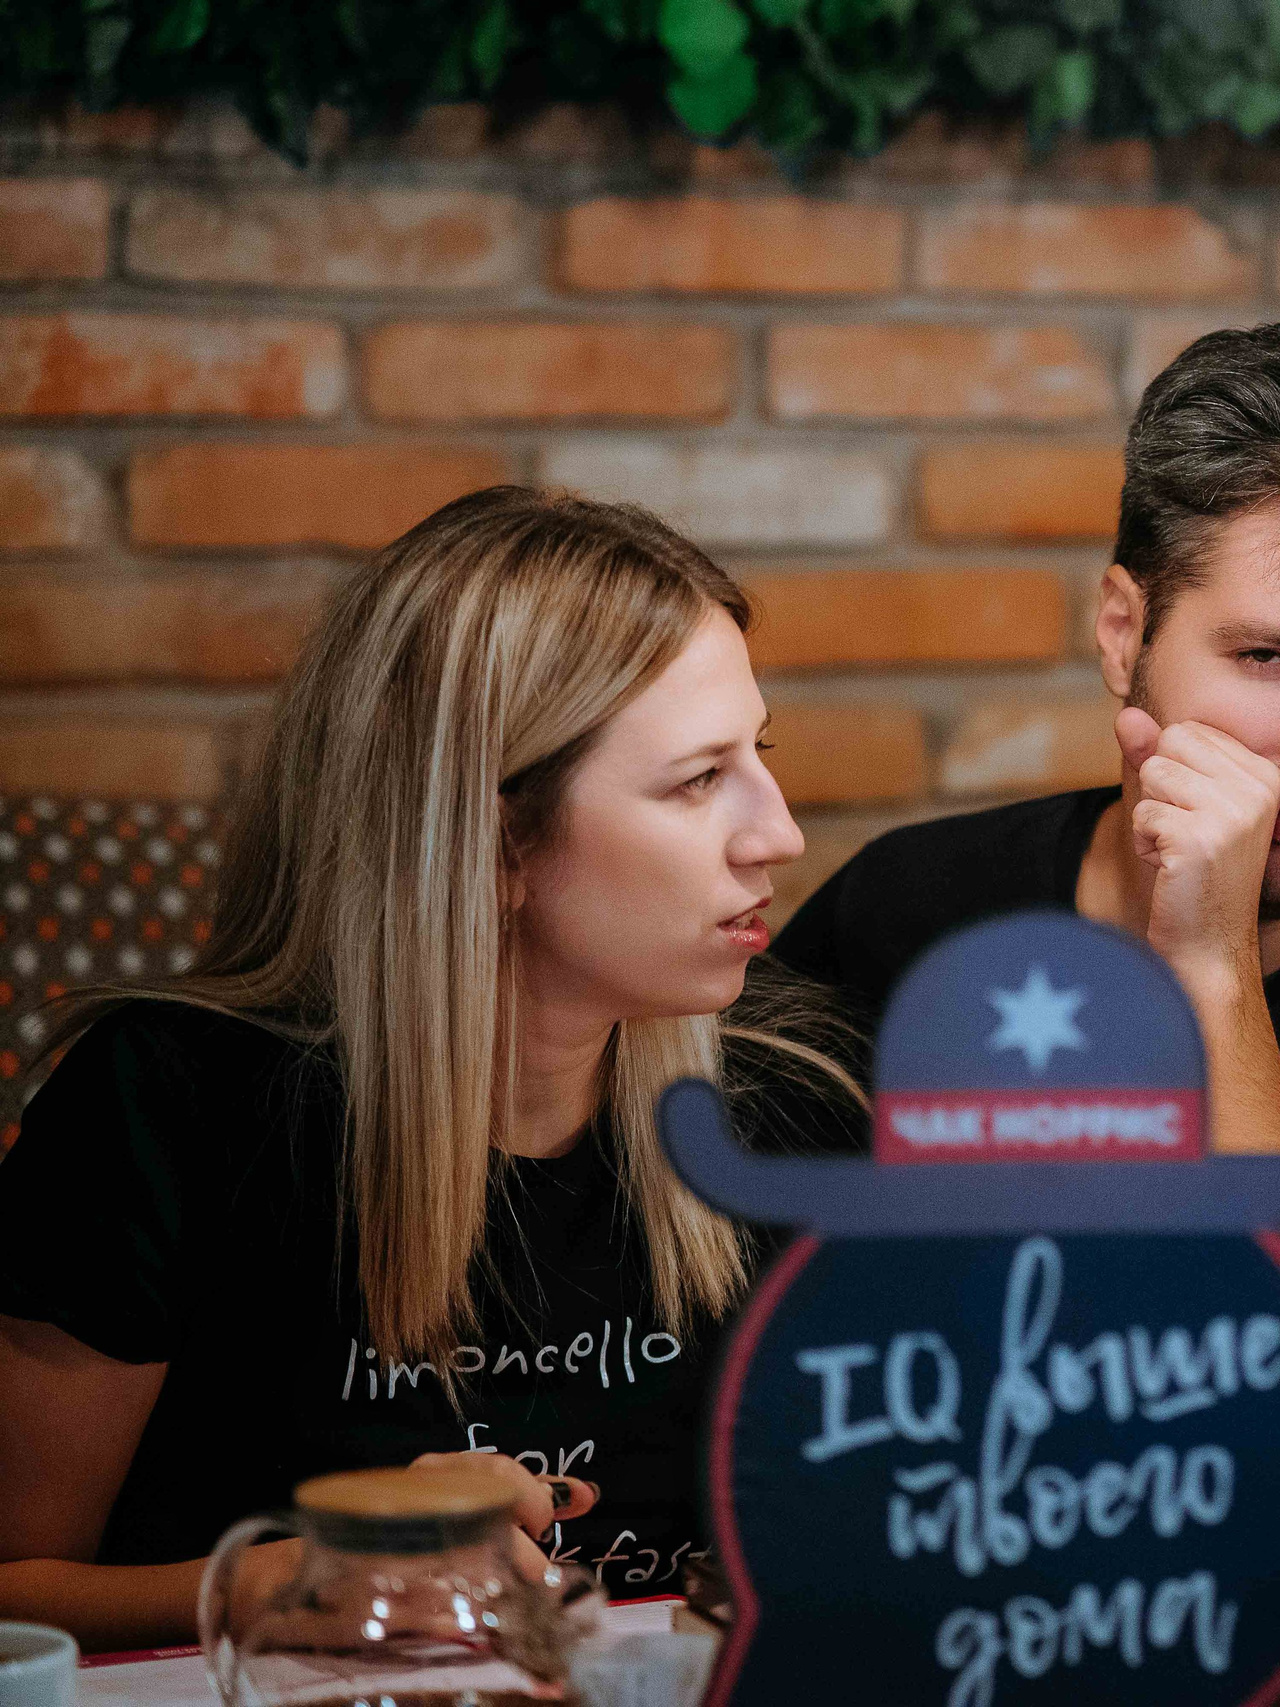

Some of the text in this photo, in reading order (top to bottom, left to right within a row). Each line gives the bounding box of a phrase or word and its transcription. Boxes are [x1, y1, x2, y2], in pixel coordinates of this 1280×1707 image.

[342, 1316, 682, 1401] limoncello
[797, 1329, 963, 1463] IQ
[887, 1382, 1236, 1578] твоего
[934, 1569, 1238, 1707] дома
